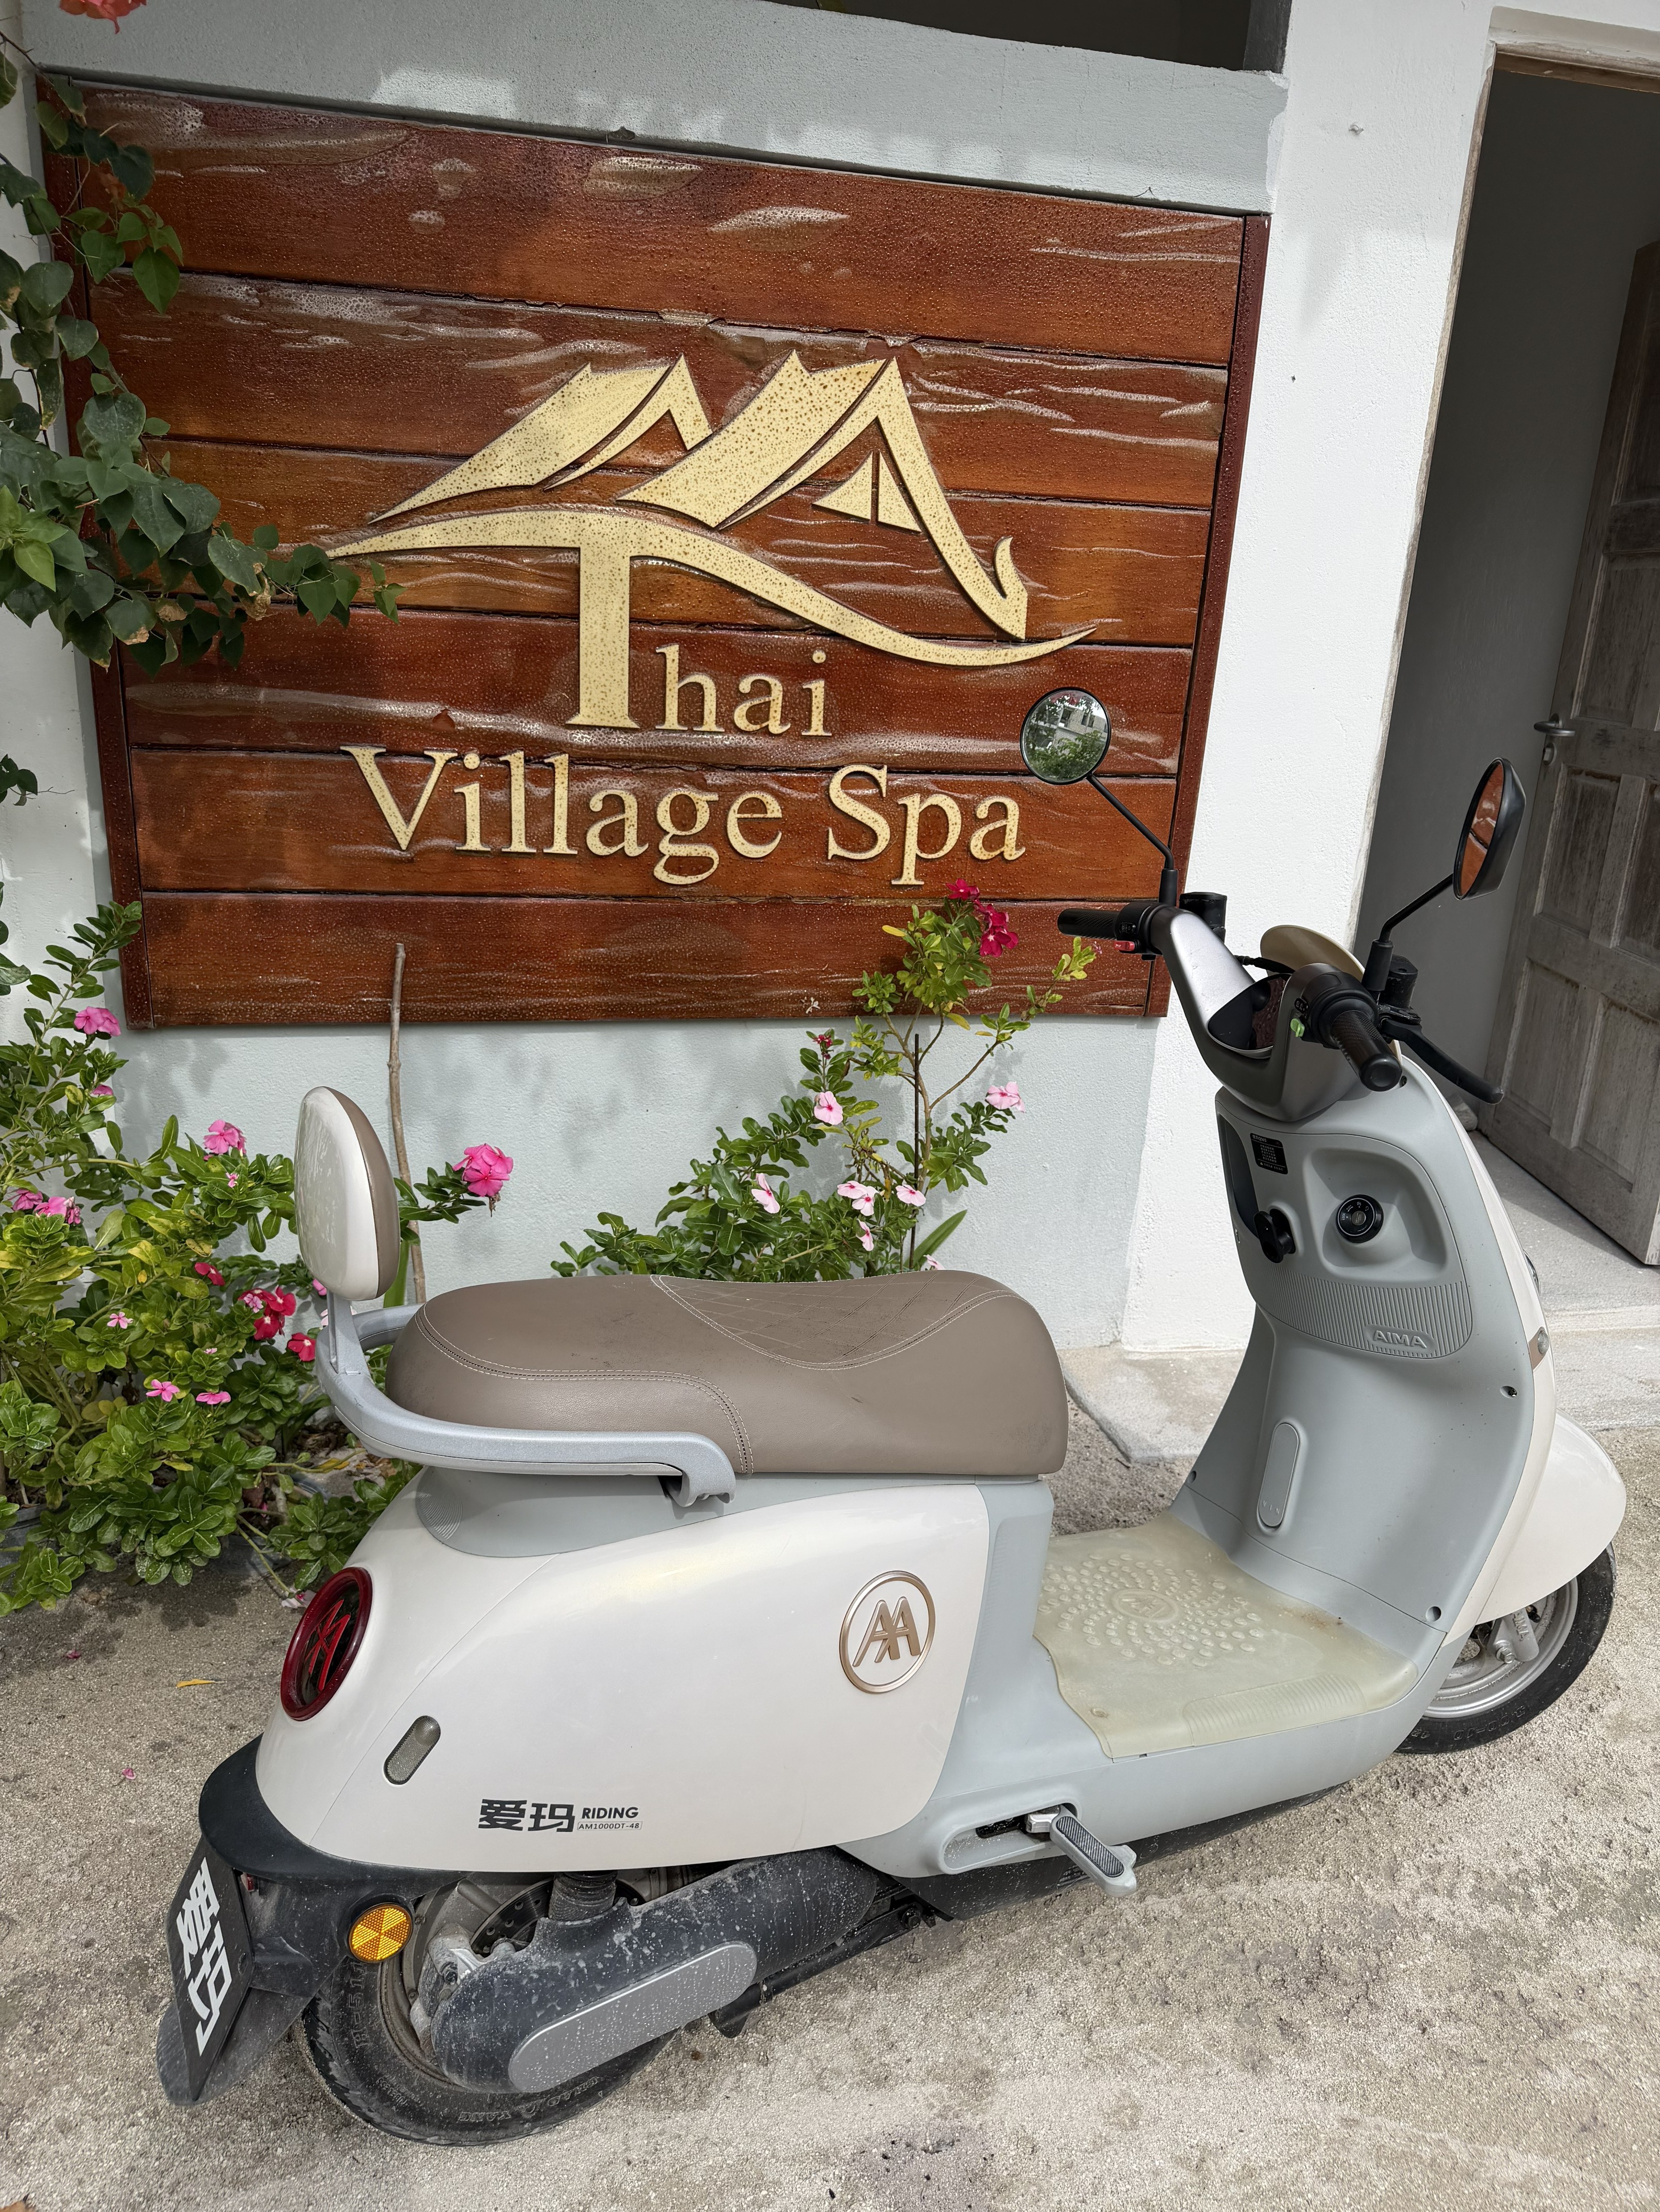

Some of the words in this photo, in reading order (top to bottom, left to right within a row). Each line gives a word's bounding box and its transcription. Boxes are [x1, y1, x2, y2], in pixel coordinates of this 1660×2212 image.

[340, 745, 784, 886] Village
[827, 764, 1027, 886] Spa
[1373, 1330, 1427, 1349] AIMA
[1262, 1500, 1280, 1515] VIN
[1453, 1705, 1526, 1741] 3.00-10
[478, 1799, 576, 1832] 爱玛
[581, 1807, 639, 1820] RIDING
[176, 1856, 232, 2057] 爱玛
[375, 2077, 409, 2107] TUBELESS
